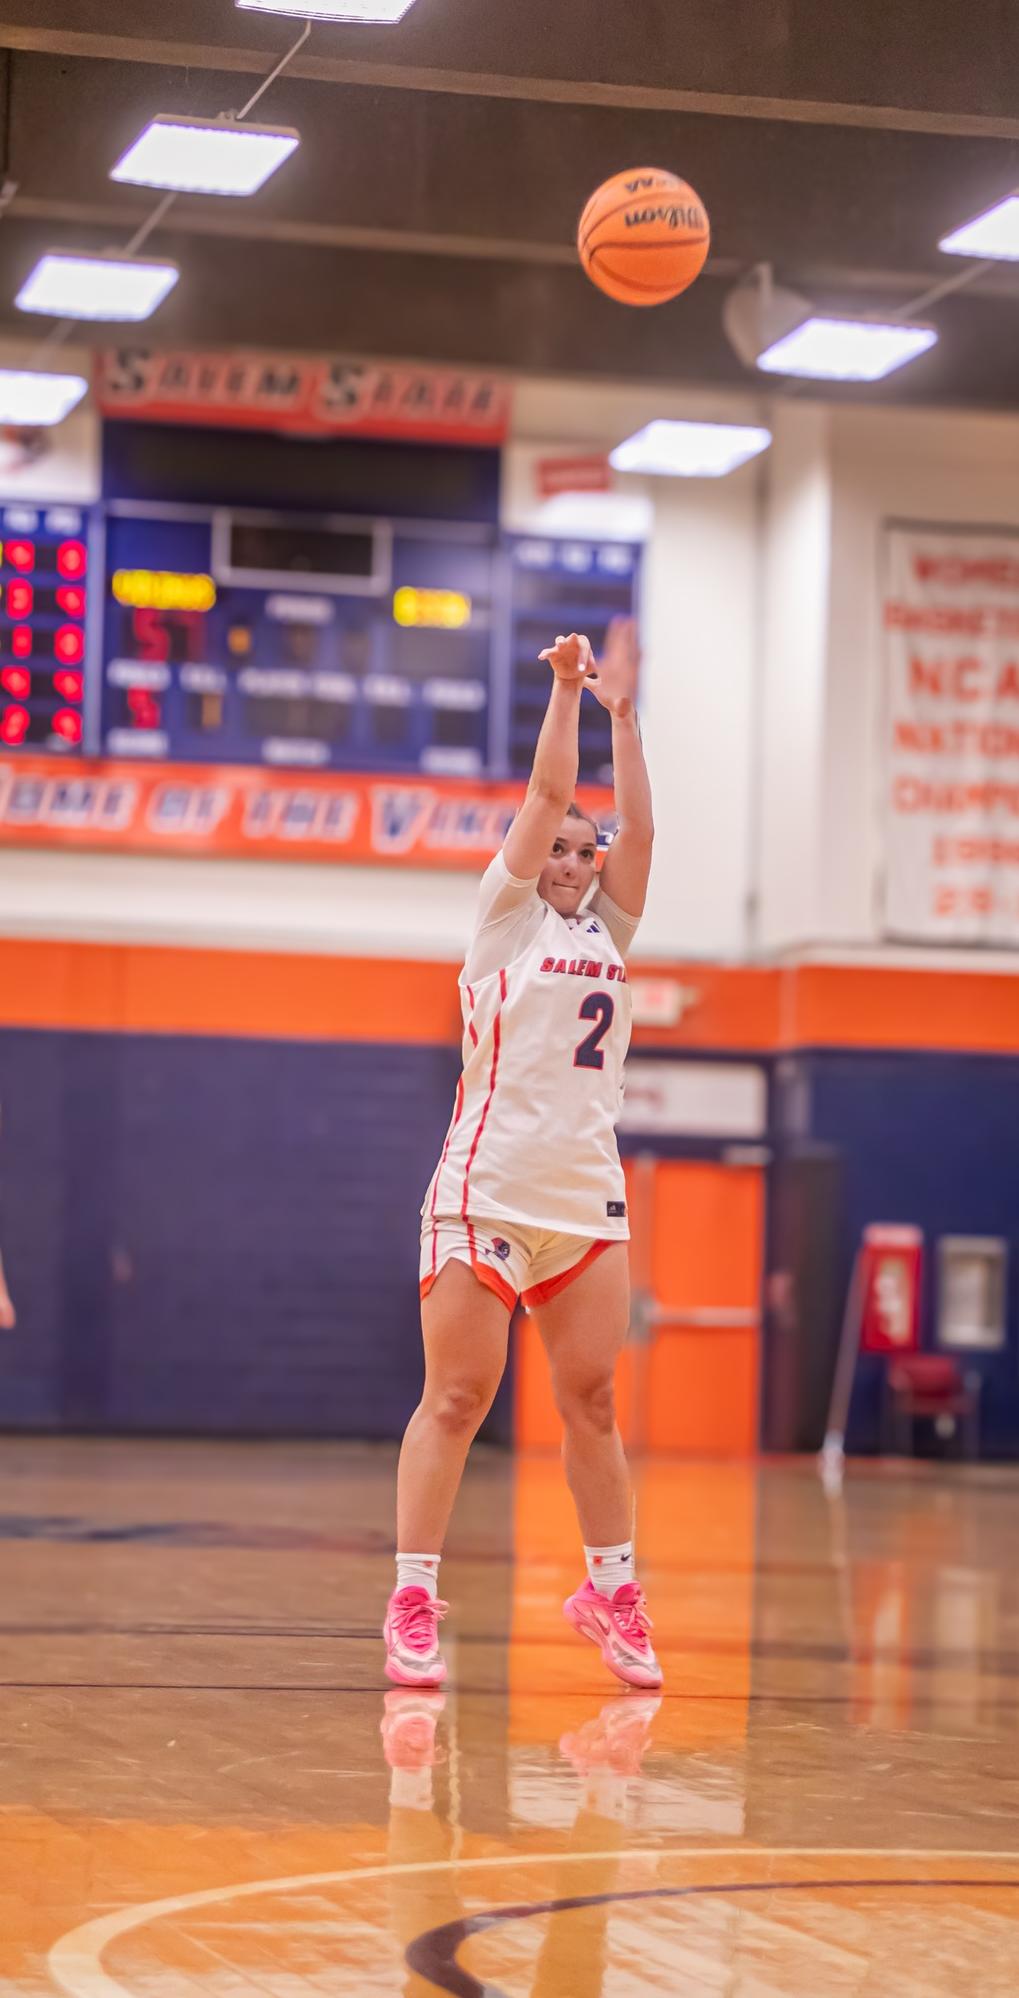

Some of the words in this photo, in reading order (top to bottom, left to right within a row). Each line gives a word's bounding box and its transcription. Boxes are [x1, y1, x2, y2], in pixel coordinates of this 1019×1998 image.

[623, 203, 705, 229] Wilson
[0, 764, 137, 830] OME
[540, 957, 603, 978] SALEM
[572, 990, 615, 1071] 2
